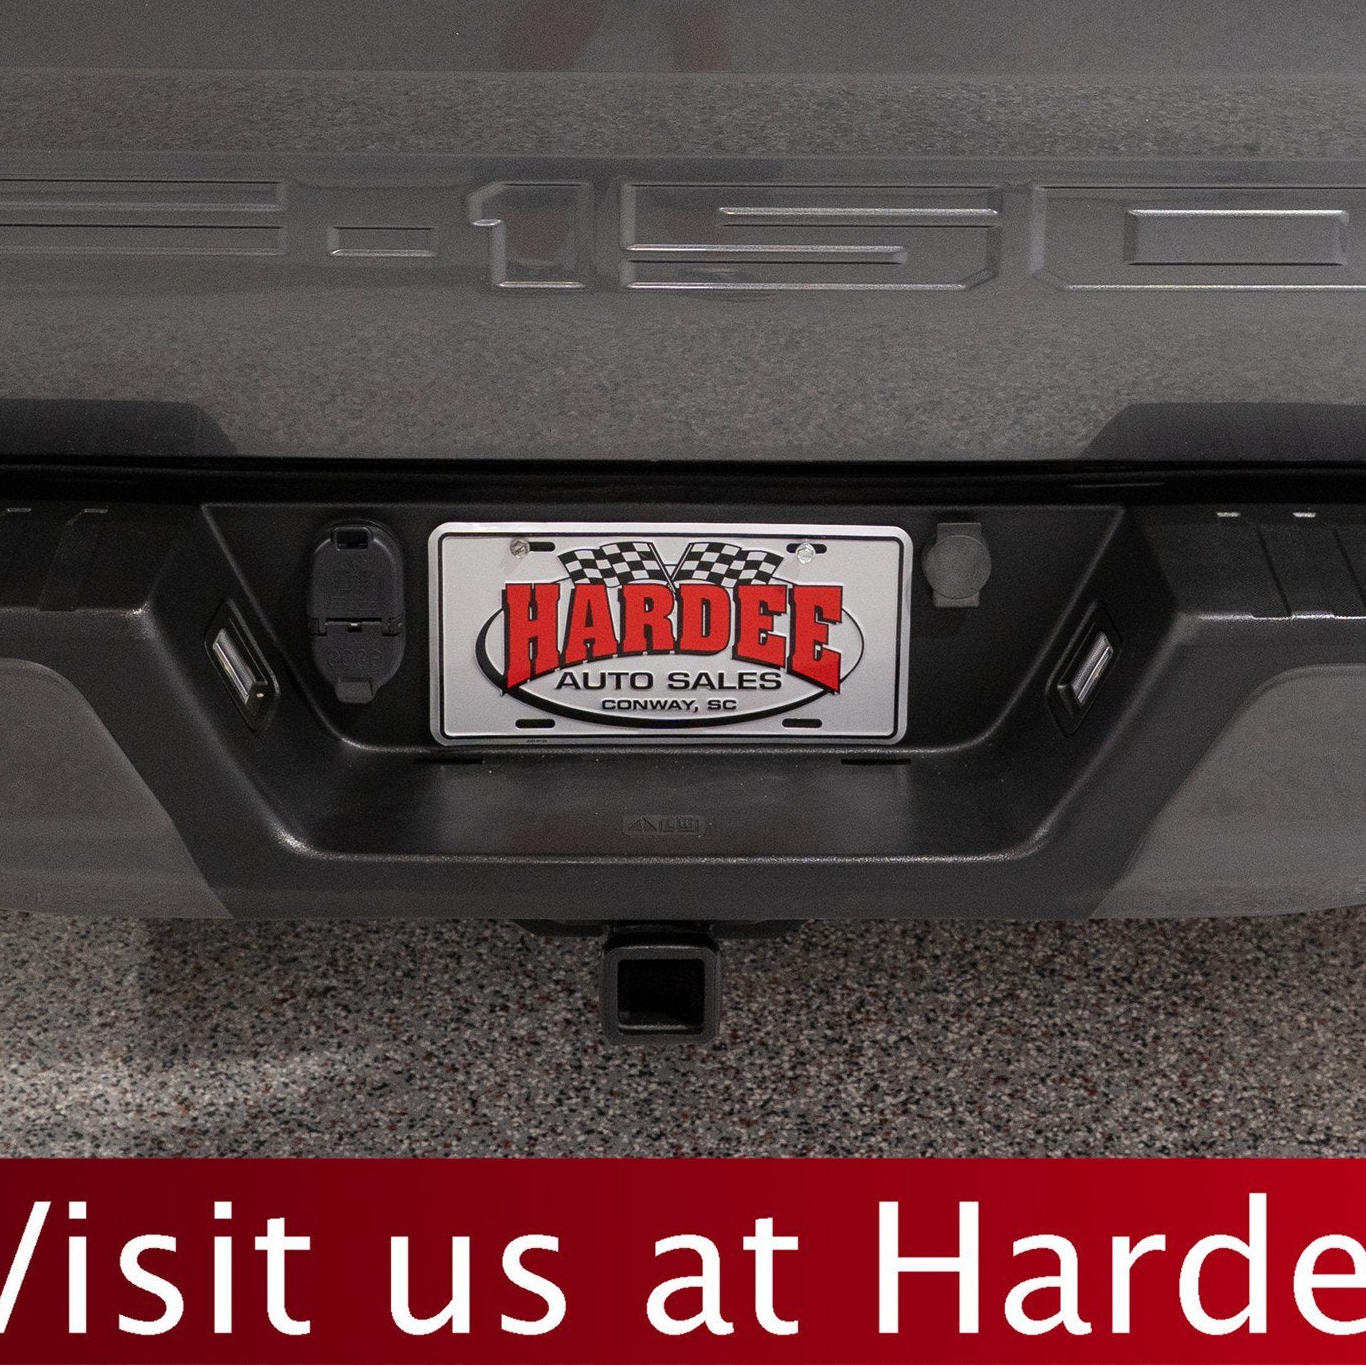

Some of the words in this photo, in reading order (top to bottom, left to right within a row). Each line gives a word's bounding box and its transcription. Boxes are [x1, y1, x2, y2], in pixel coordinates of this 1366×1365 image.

[502, 583, 844, 695] HARDEE
[555, 671, 654, 691] AUTO
[667, 671, 783, 691] SALES
[601, 698, 699, 713] CONWAY,
[707, 698, 738, 711] SC
